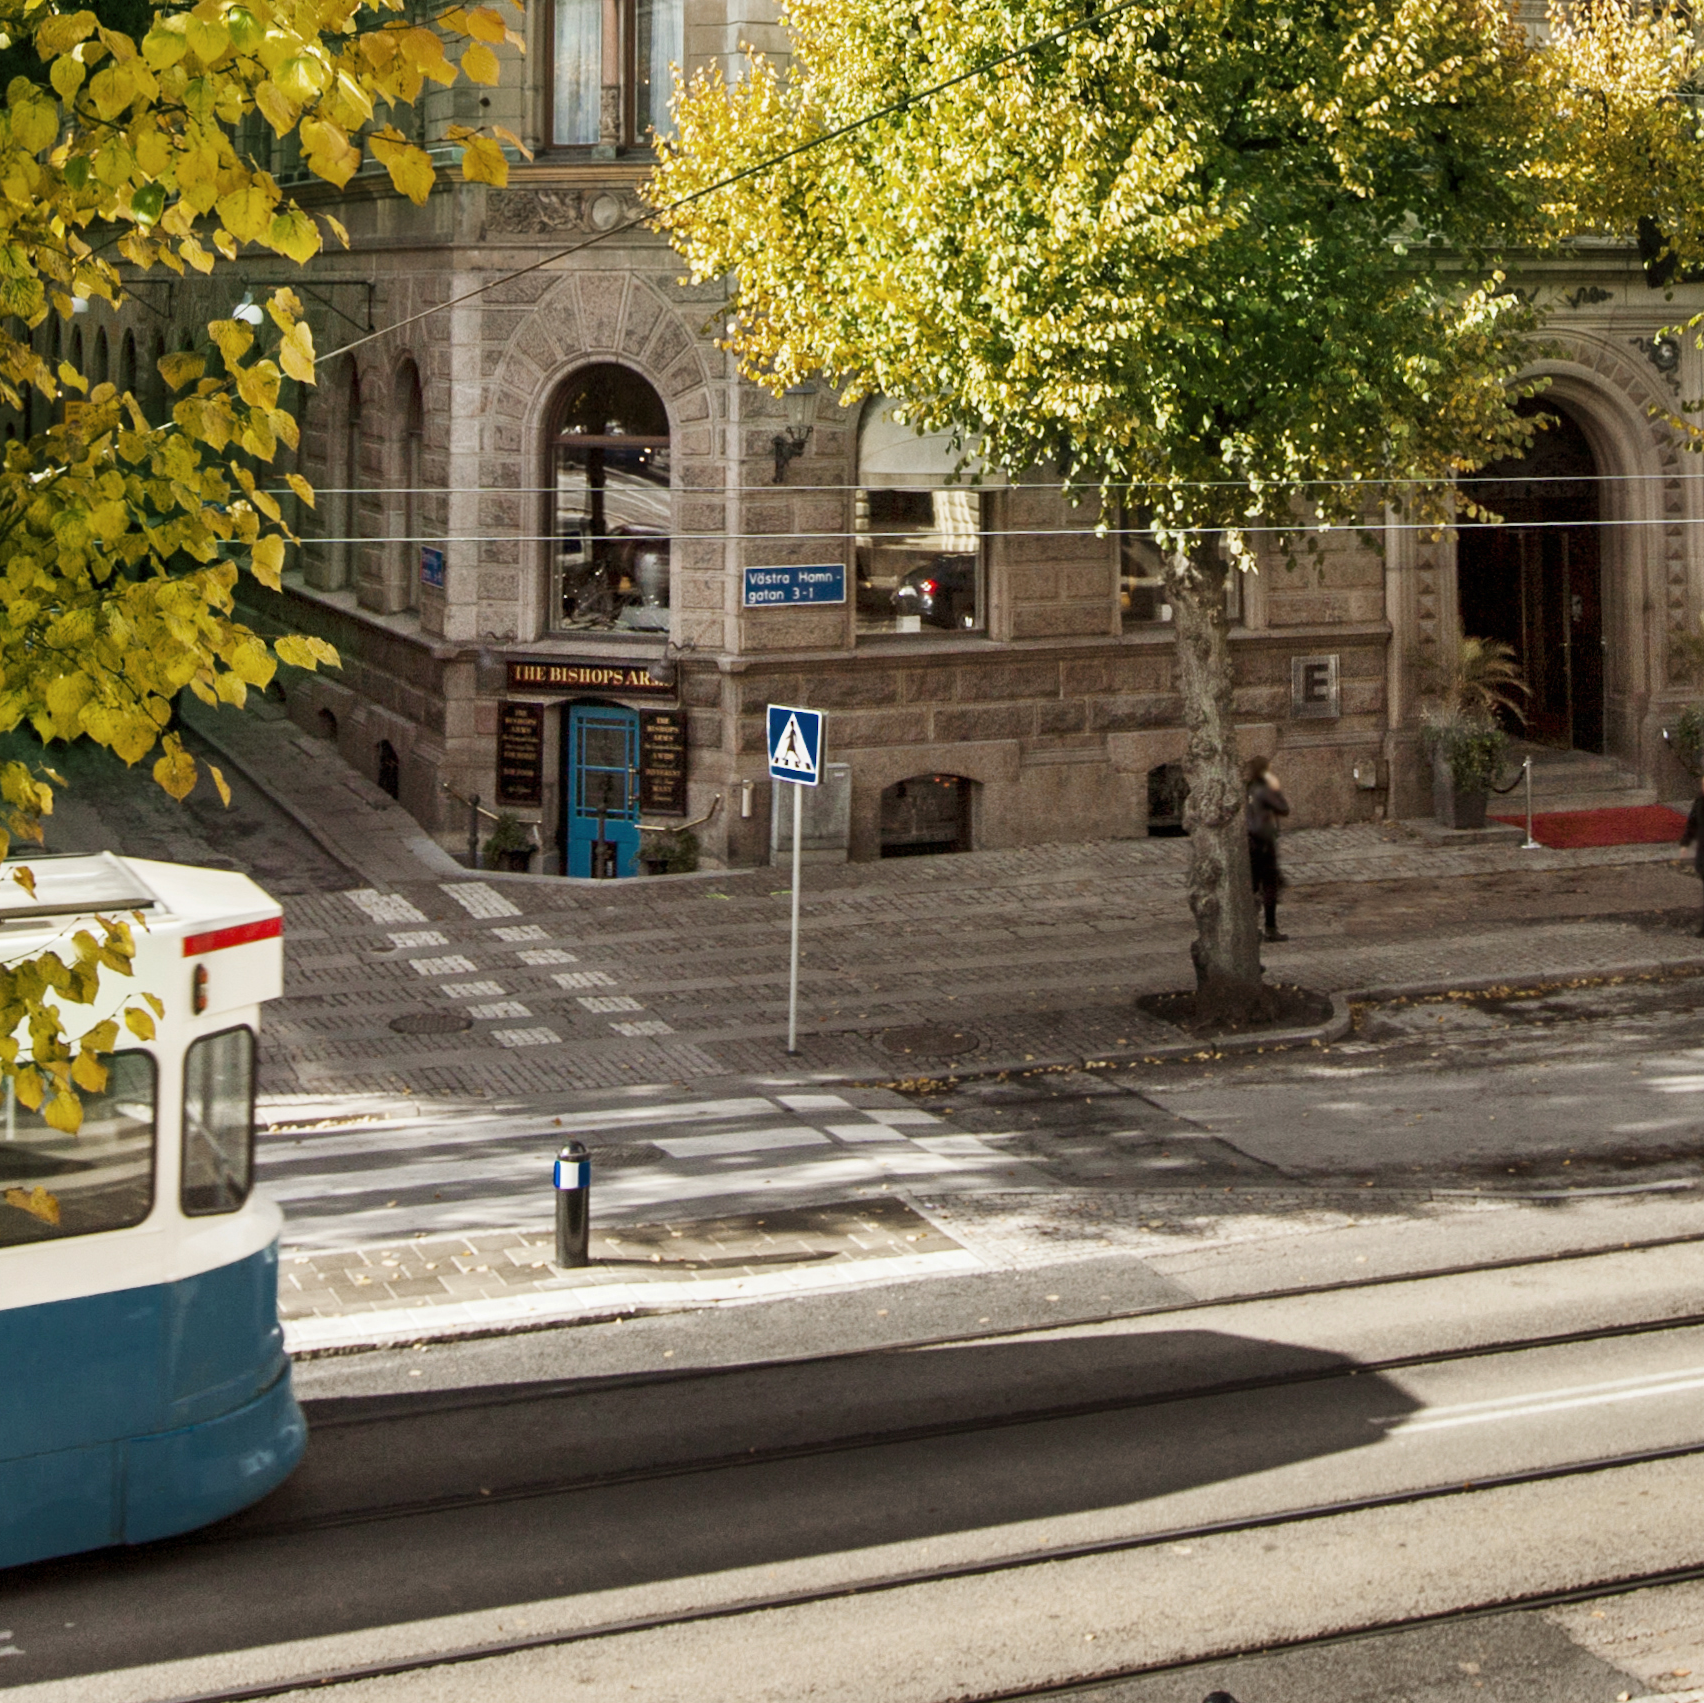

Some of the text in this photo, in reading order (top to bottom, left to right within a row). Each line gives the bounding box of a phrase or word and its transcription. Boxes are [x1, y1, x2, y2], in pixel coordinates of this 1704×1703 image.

[748, 572, 790, 585] Västra
[748, 587, 814, 604] gatan 3-1
[514, 665, 675, 688] THE BISHOPS AR
[1305, 663, 1329, 703] E
